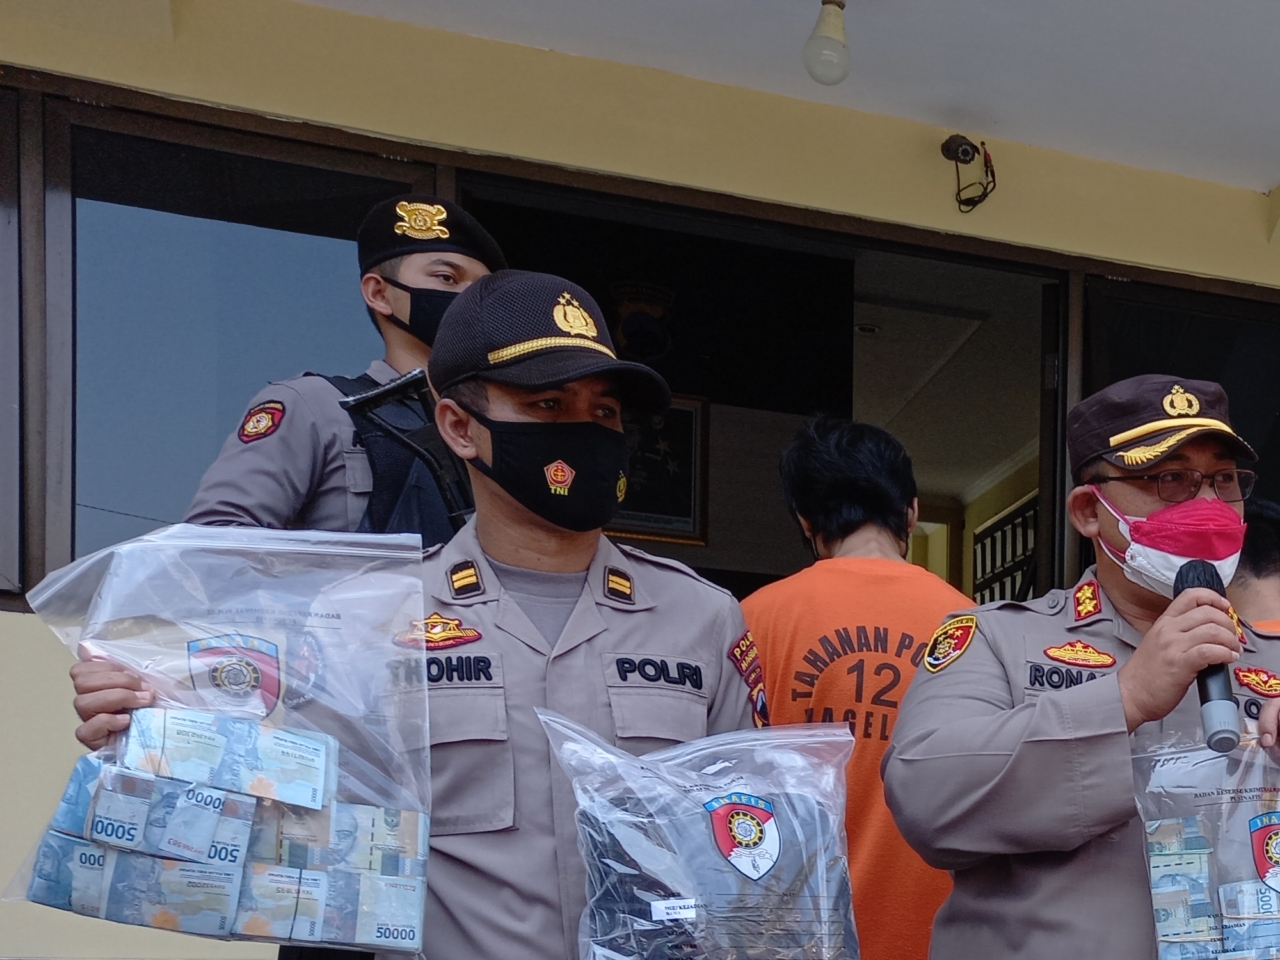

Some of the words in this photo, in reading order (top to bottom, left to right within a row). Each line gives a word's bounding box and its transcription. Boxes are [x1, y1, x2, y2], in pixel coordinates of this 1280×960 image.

[549, 485, 569, 496] TNI
[616, 657, 703, 691] POLRI
[791, 625, 889, 702] TAHANAN
[847, 659, 902, 709] 12
[1030, 664, 1106, 690] RONA
[712, 794, 767, 809] INAFIS
[92, 819, 138, 842] 5000
[308, 920, 317, 937] 50000
[375, 926, 416, 941] 50000
